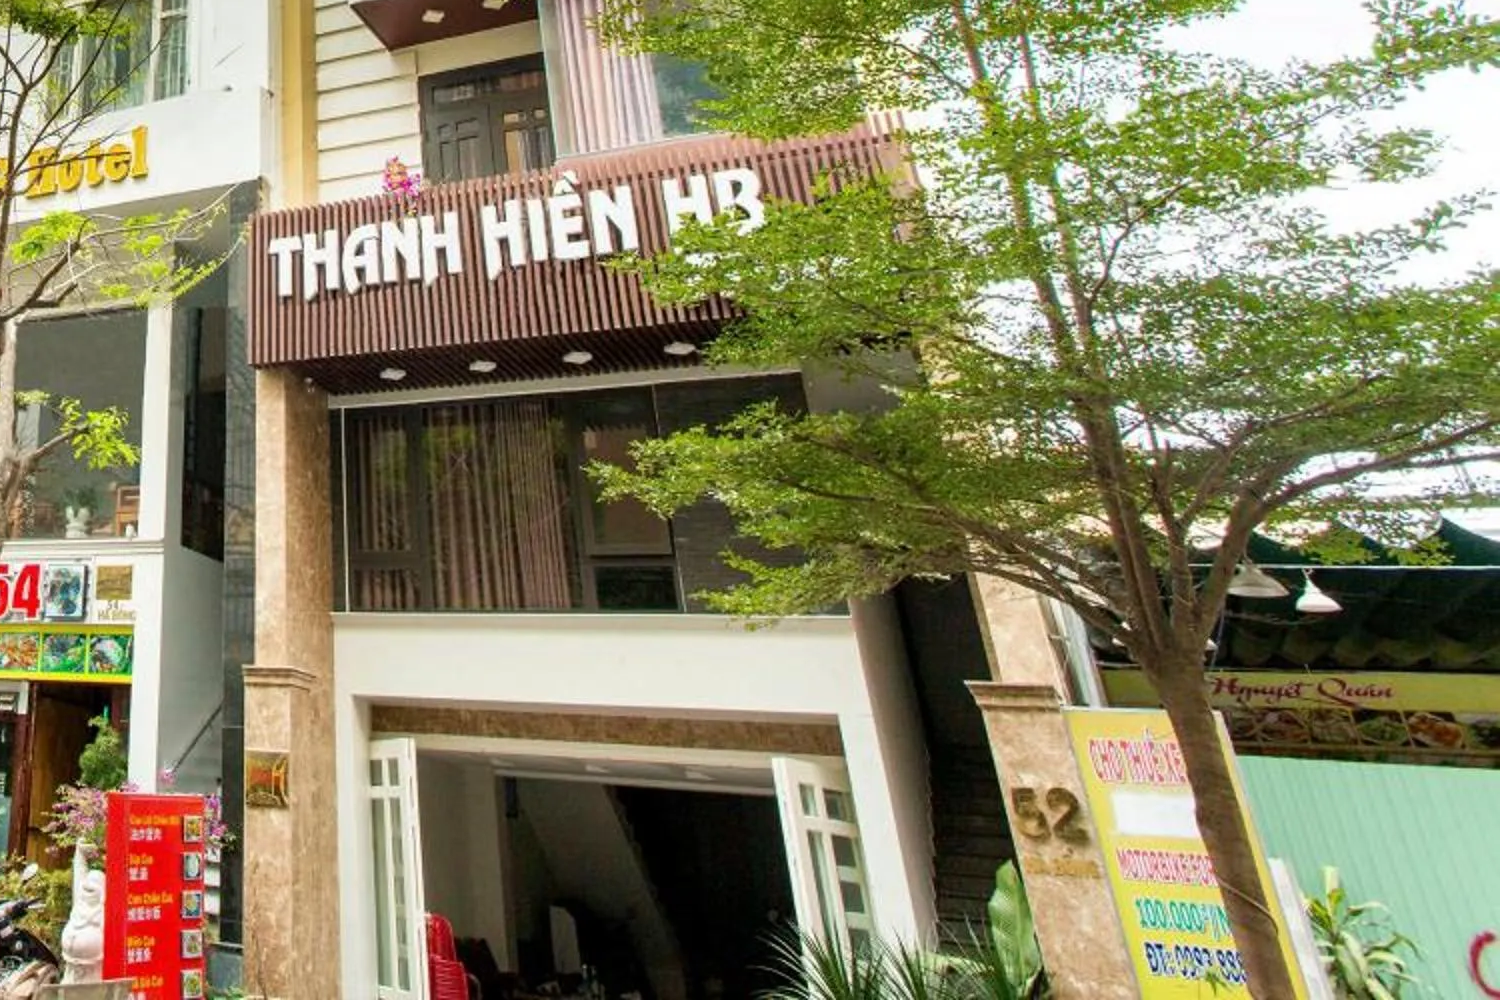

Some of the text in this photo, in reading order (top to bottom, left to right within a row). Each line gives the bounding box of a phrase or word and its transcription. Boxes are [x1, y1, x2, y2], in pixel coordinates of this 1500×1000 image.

[26, 125, 148, 199] Hotel
[269, 211, 464, 300] THANH
[1011, 787, 1090, 847] 52
